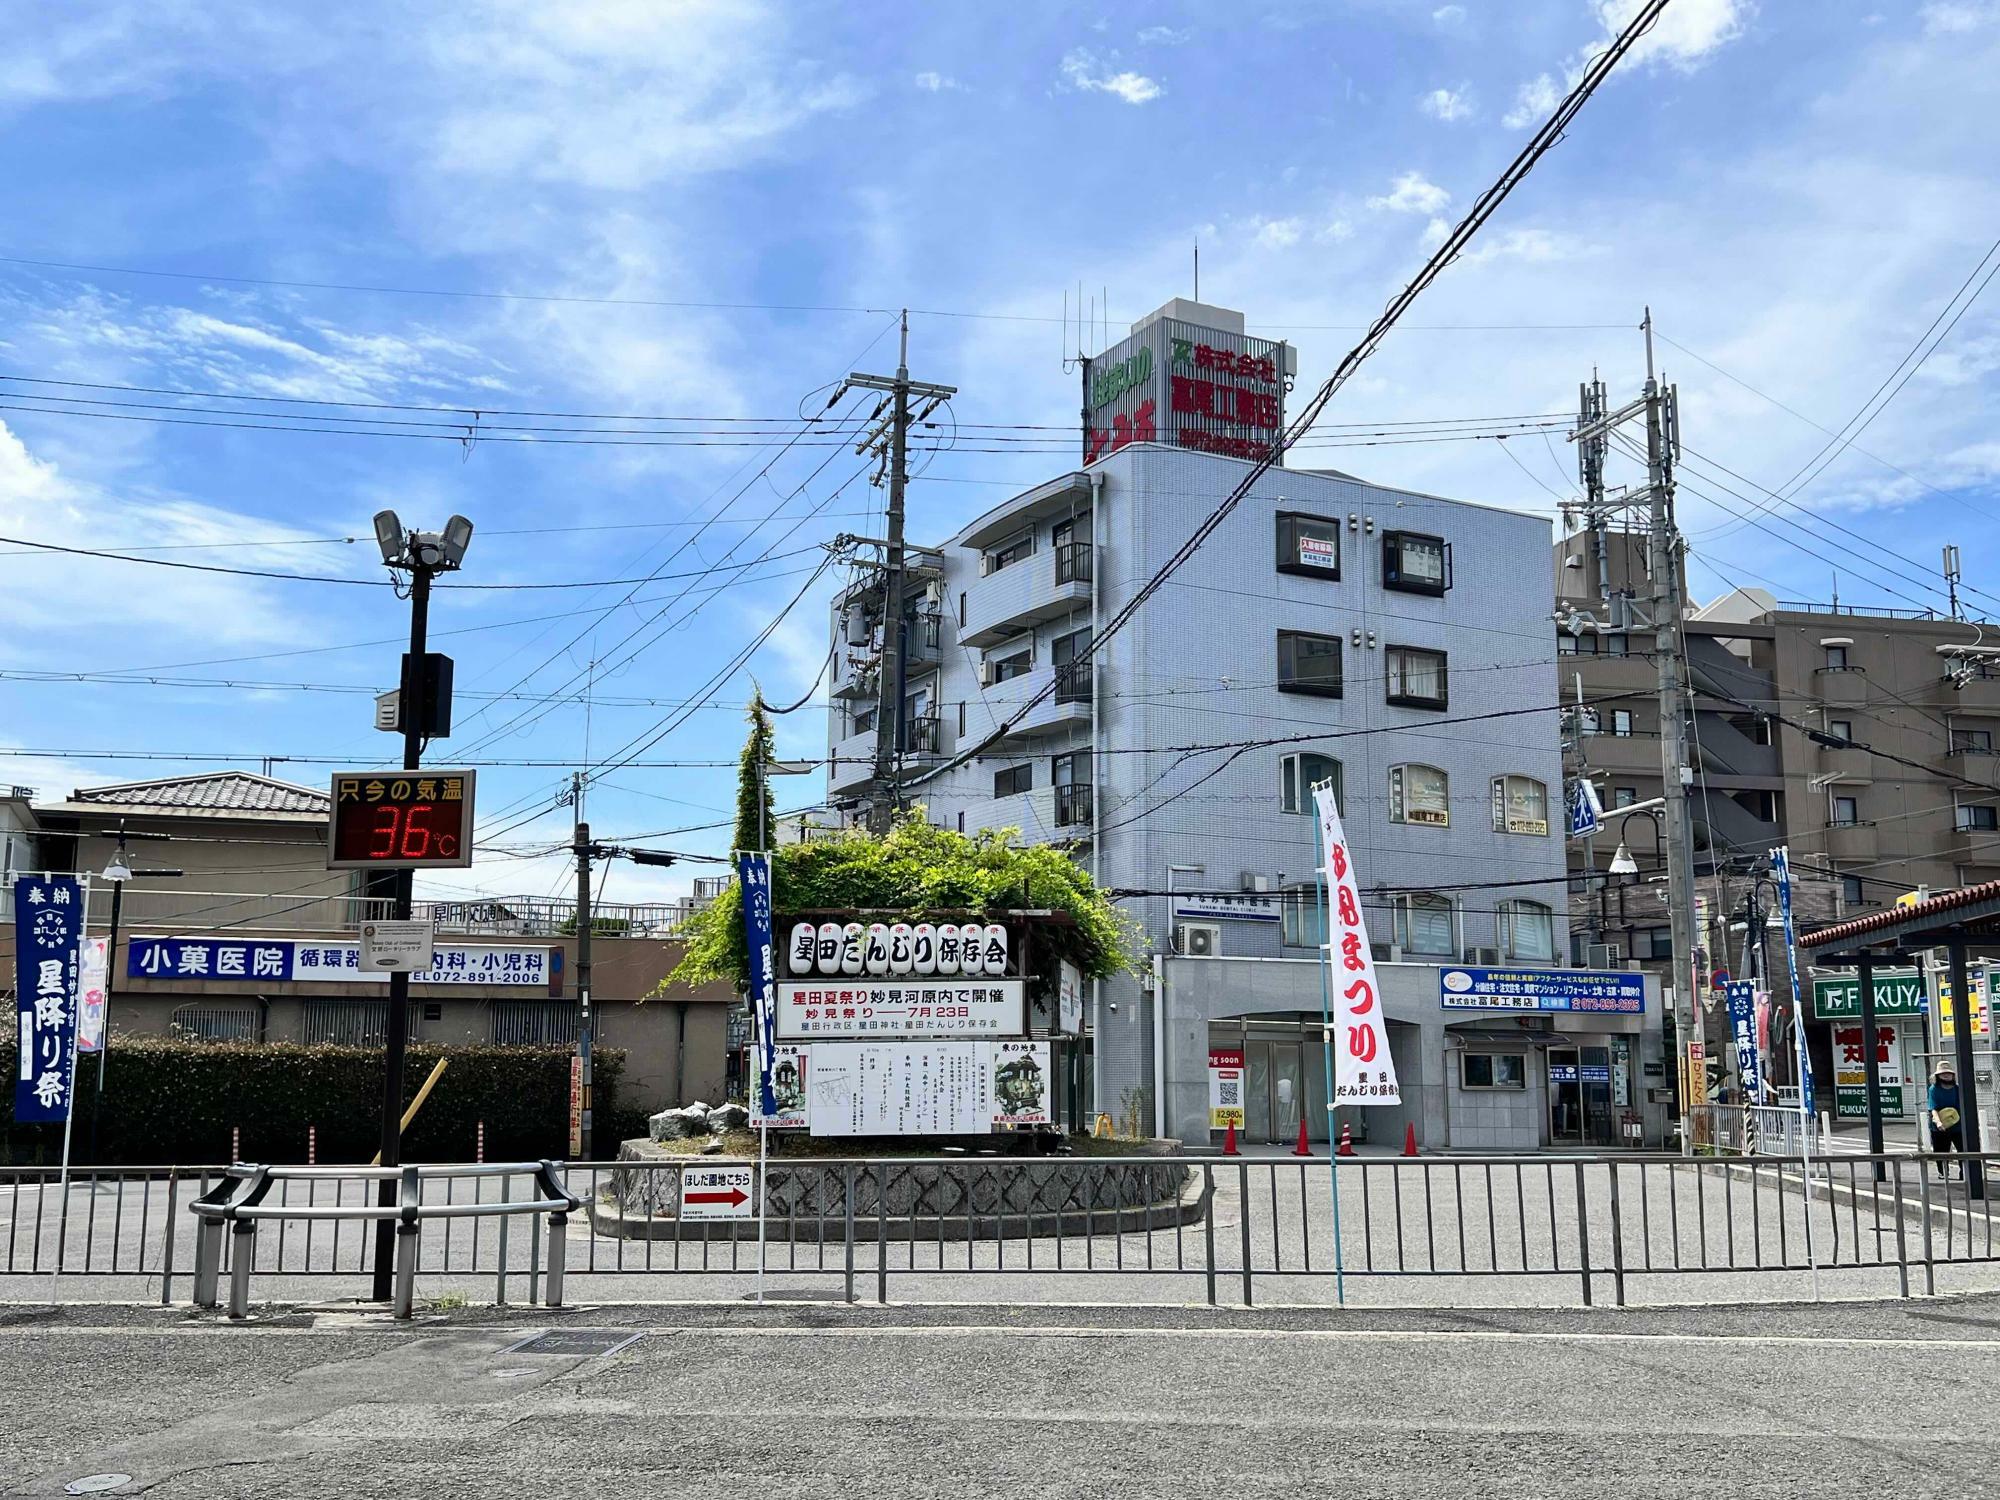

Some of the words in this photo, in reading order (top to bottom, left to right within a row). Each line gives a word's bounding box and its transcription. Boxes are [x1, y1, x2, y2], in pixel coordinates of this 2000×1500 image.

[340, 779, 463, 802] 只今の気温
[747, 867, 766, 886] 奉納
[28, 886, 70, 905] 奉納
[794, 935, 1006, 963] 星田だんじり保存会
[140, 944, 284, 976] 小菓医院
[413, 971, 540, 983] EL072-891-2006
[792, 989, 1005, 1005] 星田夏祭り妙見河原内で開催
[1846, 984, 1920, 1009] FKUY
[805, 1007, 873, 1019] 妙見祭り
[32, 959, 67, 1108] 星降り祭
[773, 1047, 799, 1055] の地車
[1736, 1020, 1756, 1086] 星降り祭
[684, 1173, 750, 1186] ほしだ園地こちら
